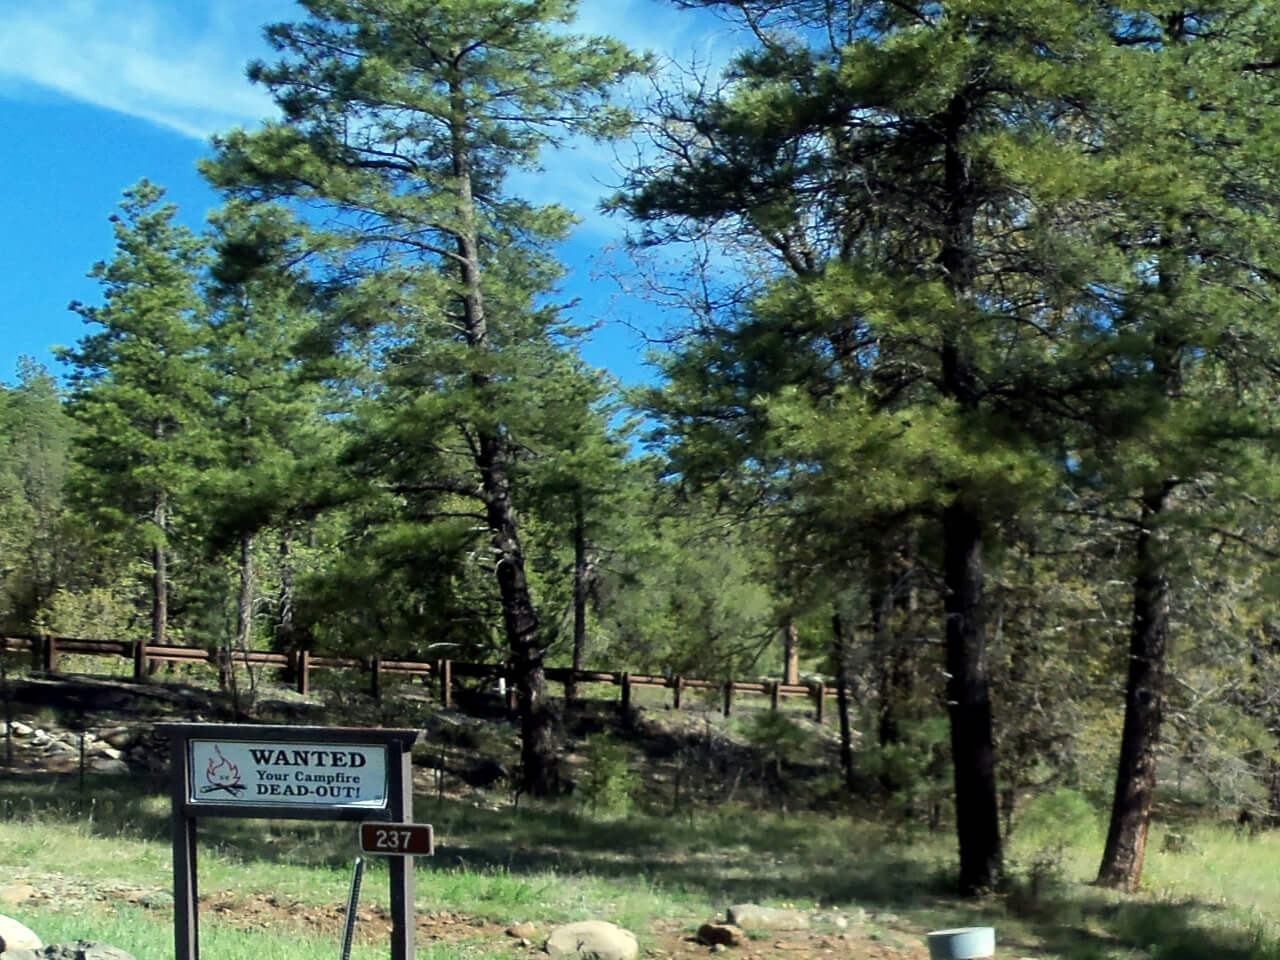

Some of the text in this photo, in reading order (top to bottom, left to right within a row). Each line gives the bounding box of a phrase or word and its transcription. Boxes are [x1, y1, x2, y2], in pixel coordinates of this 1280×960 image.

[250, 749, 366, 767] WANTED
[256, 769, 361, 784] Your Campfire
[256, 783, 361, 799] DEAD-OUT!
[375, 830, 412, 849] 237
